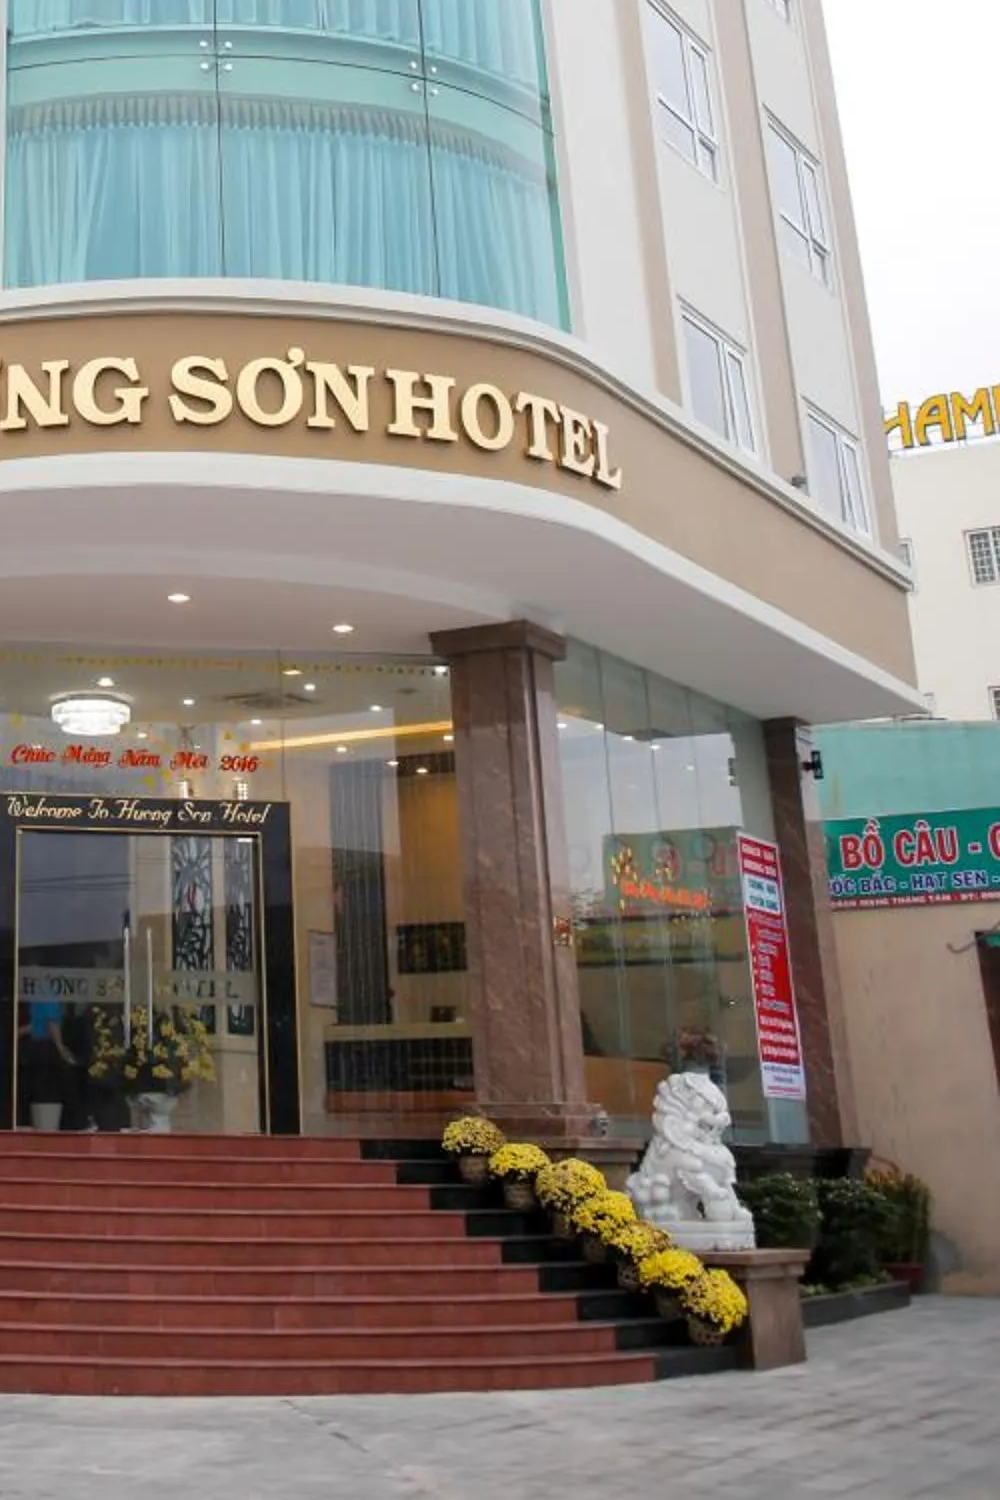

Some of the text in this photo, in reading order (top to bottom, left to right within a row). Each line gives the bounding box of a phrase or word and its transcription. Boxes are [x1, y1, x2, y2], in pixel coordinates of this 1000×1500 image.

[167, 346, 369, 432] SƠN
[386, 371, 623, 490] HOTEL
[7, 795, 273, 827] Welcome To Huong Son Hotel
[840, 818, 885, 871] BỒ
[894, 819, 959, 866] CÂU
[828, 873, 856, 897] ỐC
[911, 871, 947, 893] HẠT
[952, 869, 988, 889] SEN
